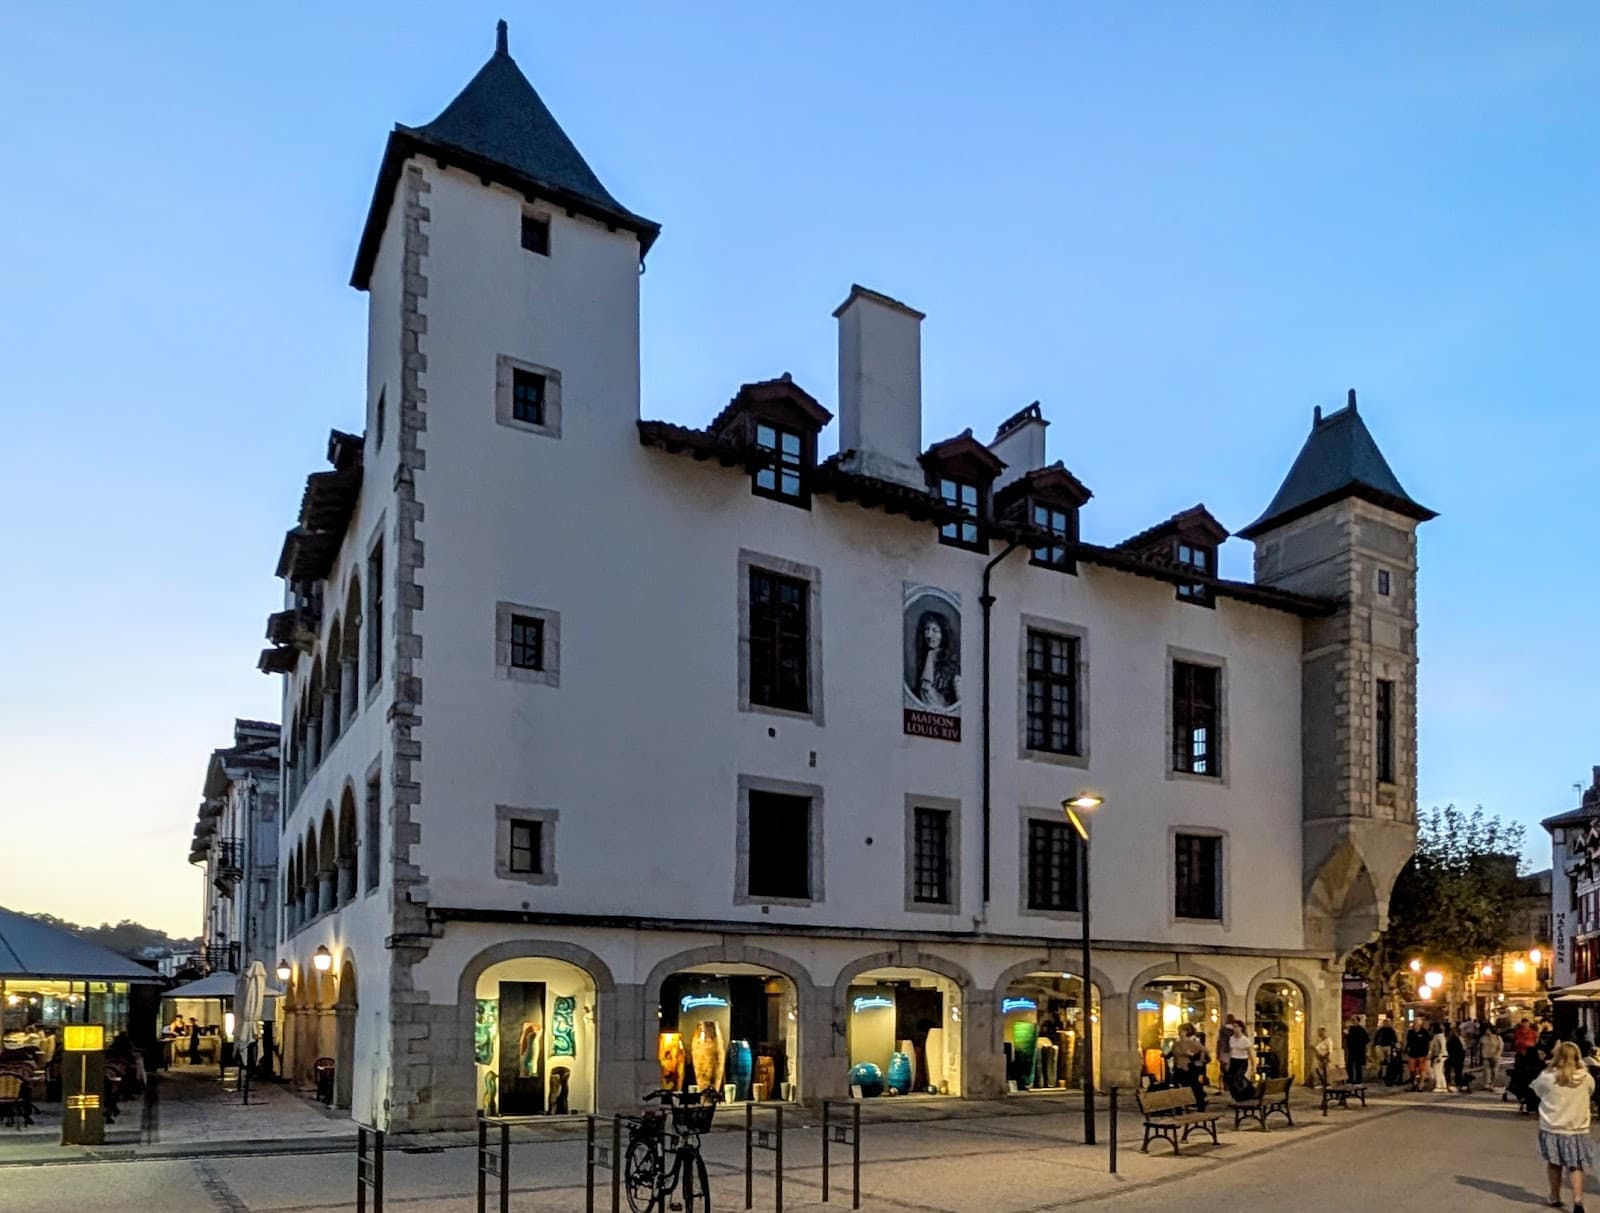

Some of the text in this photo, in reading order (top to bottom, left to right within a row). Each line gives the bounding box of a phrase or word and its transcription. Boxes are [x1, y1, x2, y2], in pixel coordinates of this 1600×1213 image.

[911, 712, 954, 727] MAISON
[906, 721, 959, 738] LOUIS XIV
